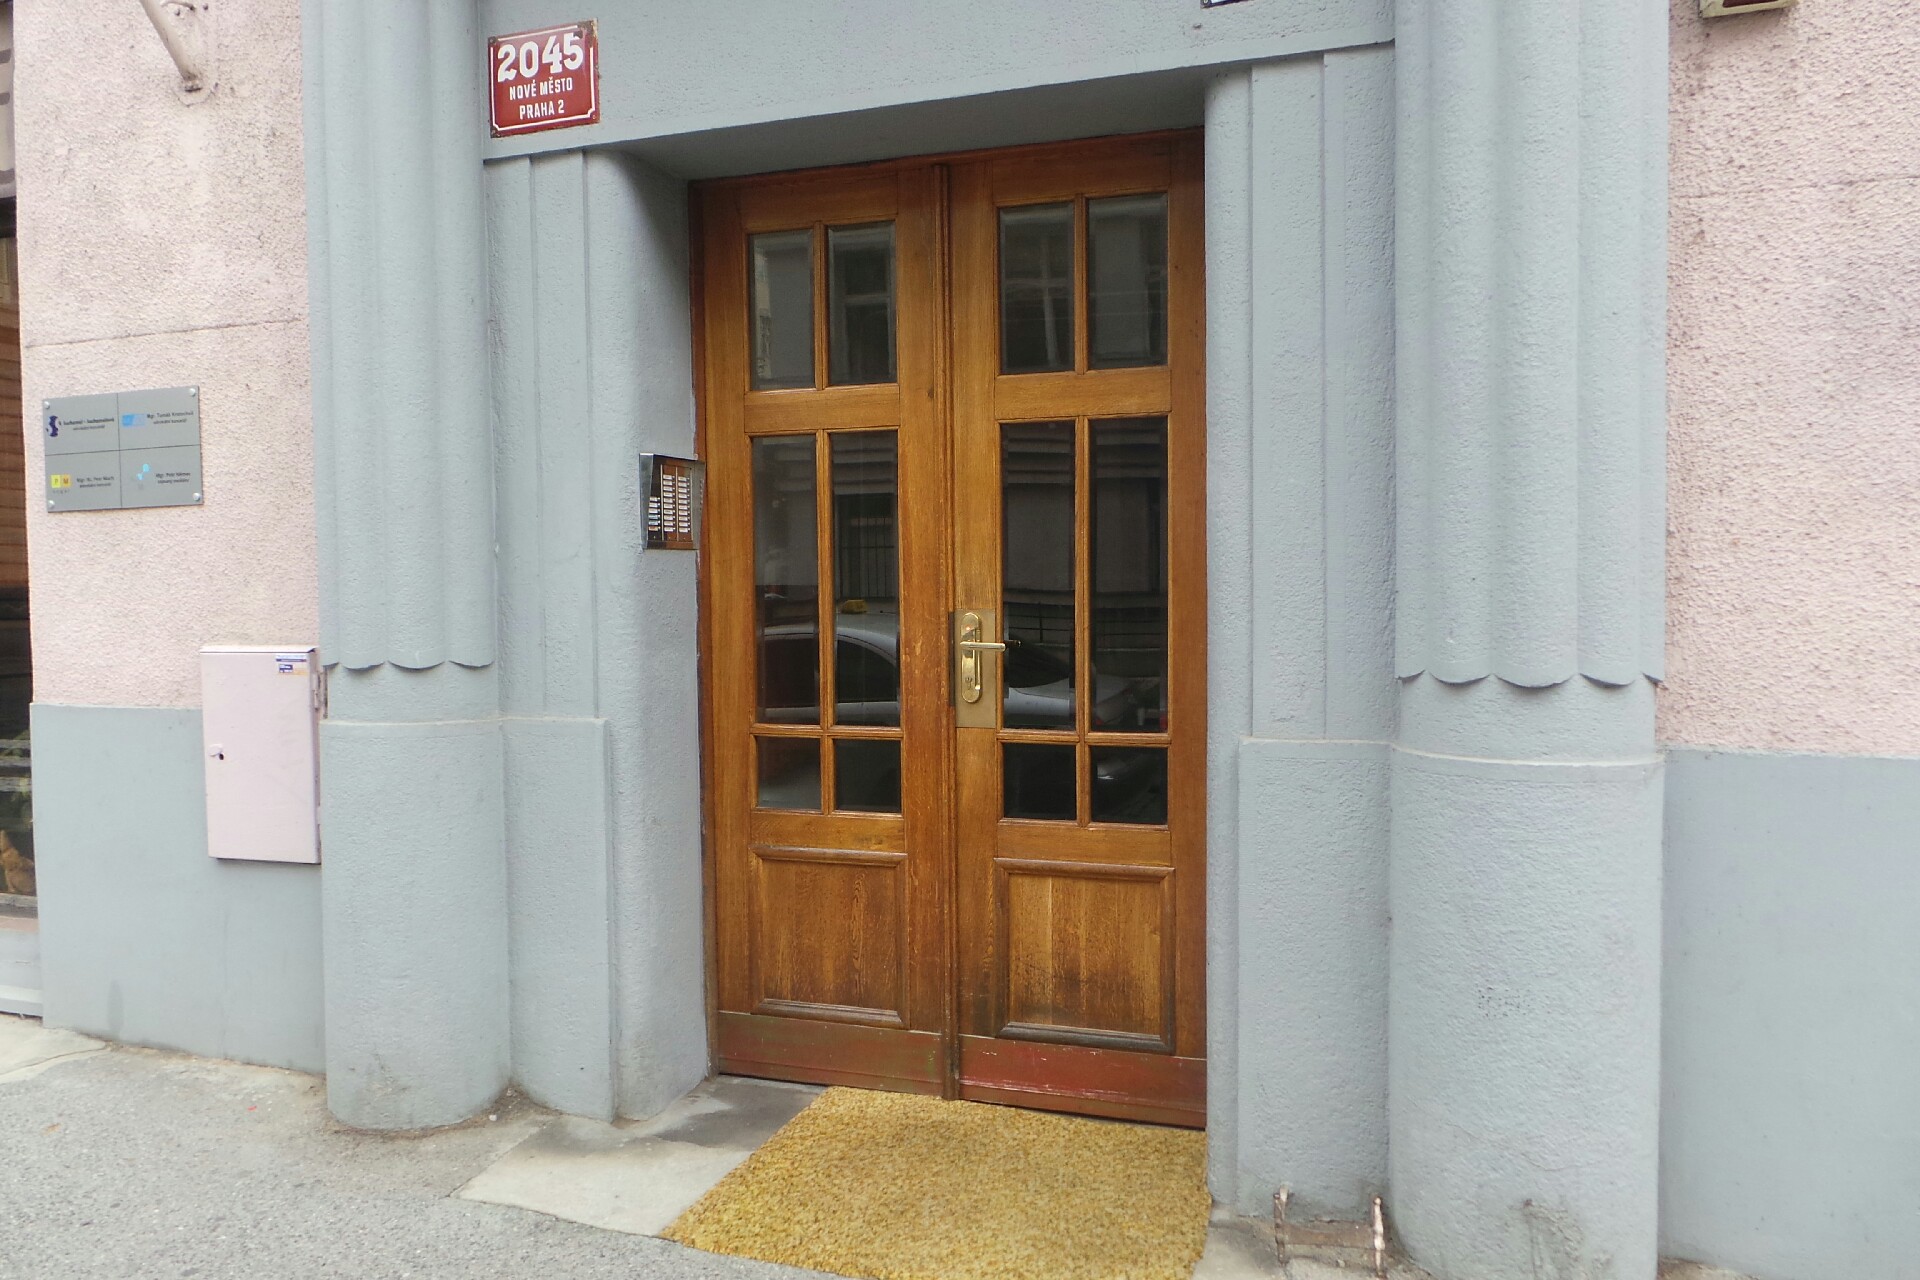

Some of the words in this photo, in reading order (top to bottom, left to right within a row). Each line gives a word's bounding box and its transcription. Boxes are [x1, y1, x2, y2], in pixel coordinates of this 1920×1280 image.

[497, 32, 584, 83] 2045
[509, 79, 537, 101] NOVÉ
[539, 76, 573, 96] MĚSTO
[519, 100, 555, 120] PRAHA
[557, 99, 565, 114] 2
